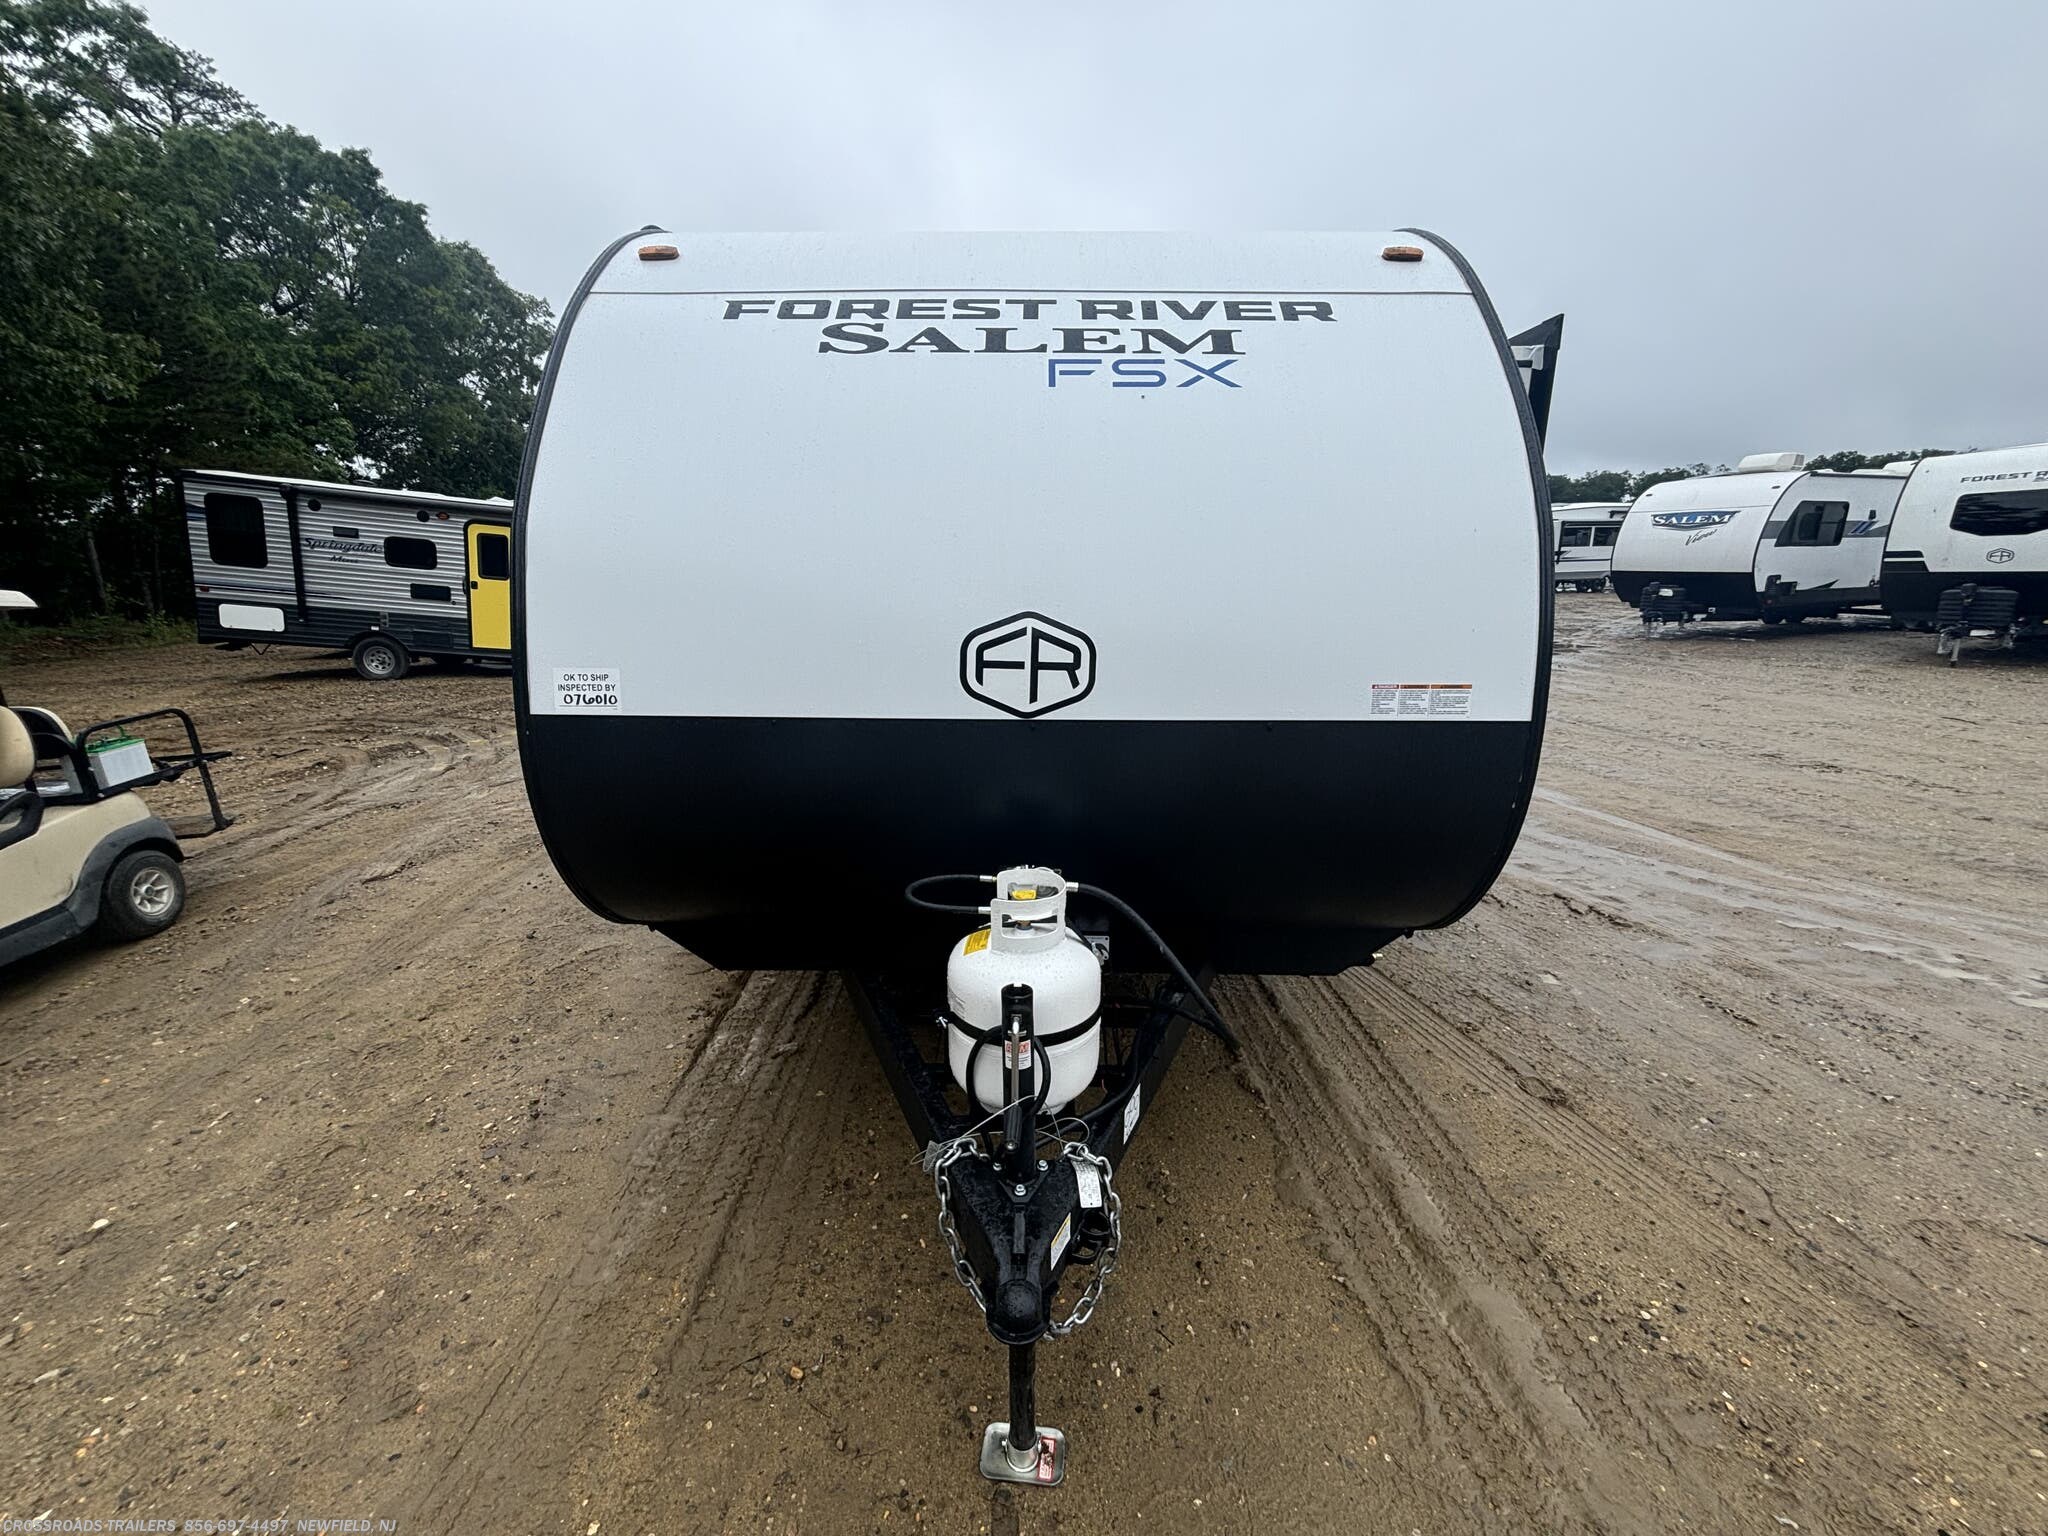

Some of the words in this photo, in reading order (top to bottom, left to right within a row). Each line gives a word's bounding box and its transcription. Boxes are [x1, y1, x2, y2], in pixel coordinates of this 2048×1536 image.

[722, 299, 1057, 320] FOREST
[1076, 299, 1338, 322] RIVER
[818, 322, 1246, 354] SALEM
[1048, 358, 1243, 388] FSX
[1960, 471, 2033, 483] FOREST
[1654, 514, 1731, 524] SALEM
[563, 673, 576, 682] OK
[577, 673, 589, 682] TO
[590, 673, 609, 682] SHIP
[558, 683, 603, 692] INSPECTED
[605, 683, 616, 692] BY
[563, 693, 618, 706] 076010
